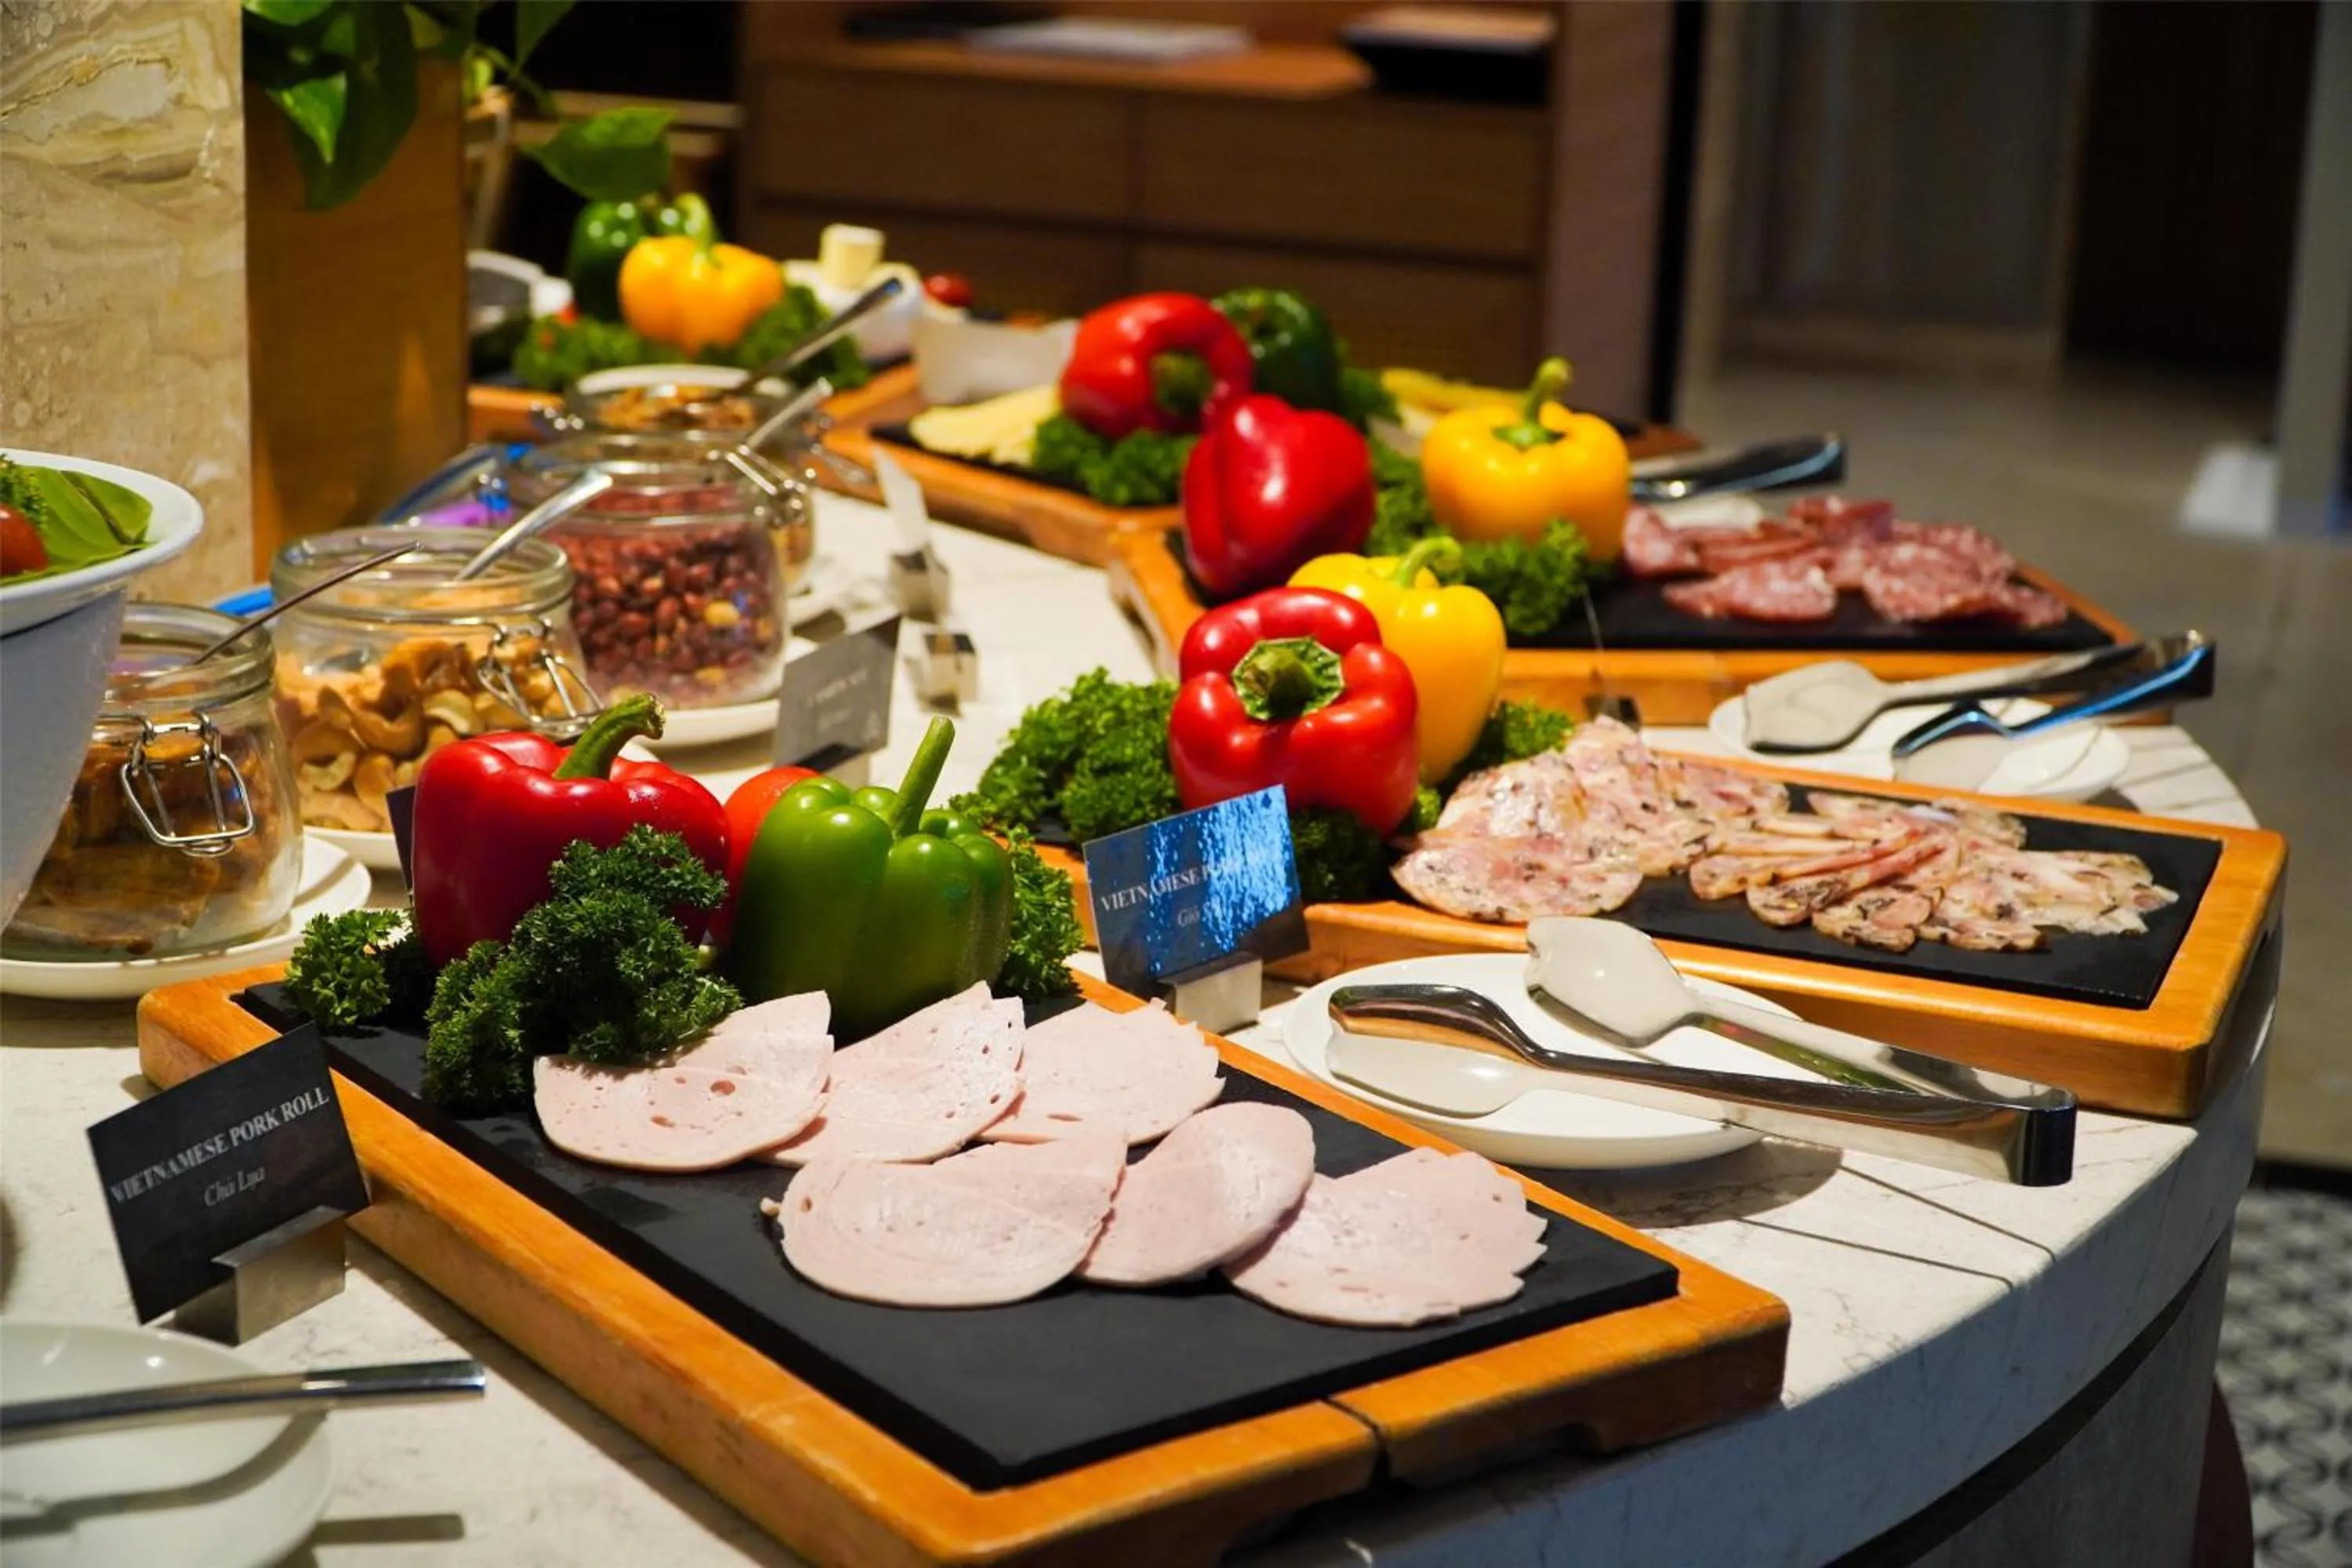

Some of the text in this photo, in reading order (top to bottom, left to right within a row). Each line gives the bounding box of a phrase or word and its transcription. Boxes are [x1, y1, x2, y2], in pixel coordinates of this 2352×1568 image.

[111, 1087, 329, 1202] VIETNAMESE PORK ROLL
